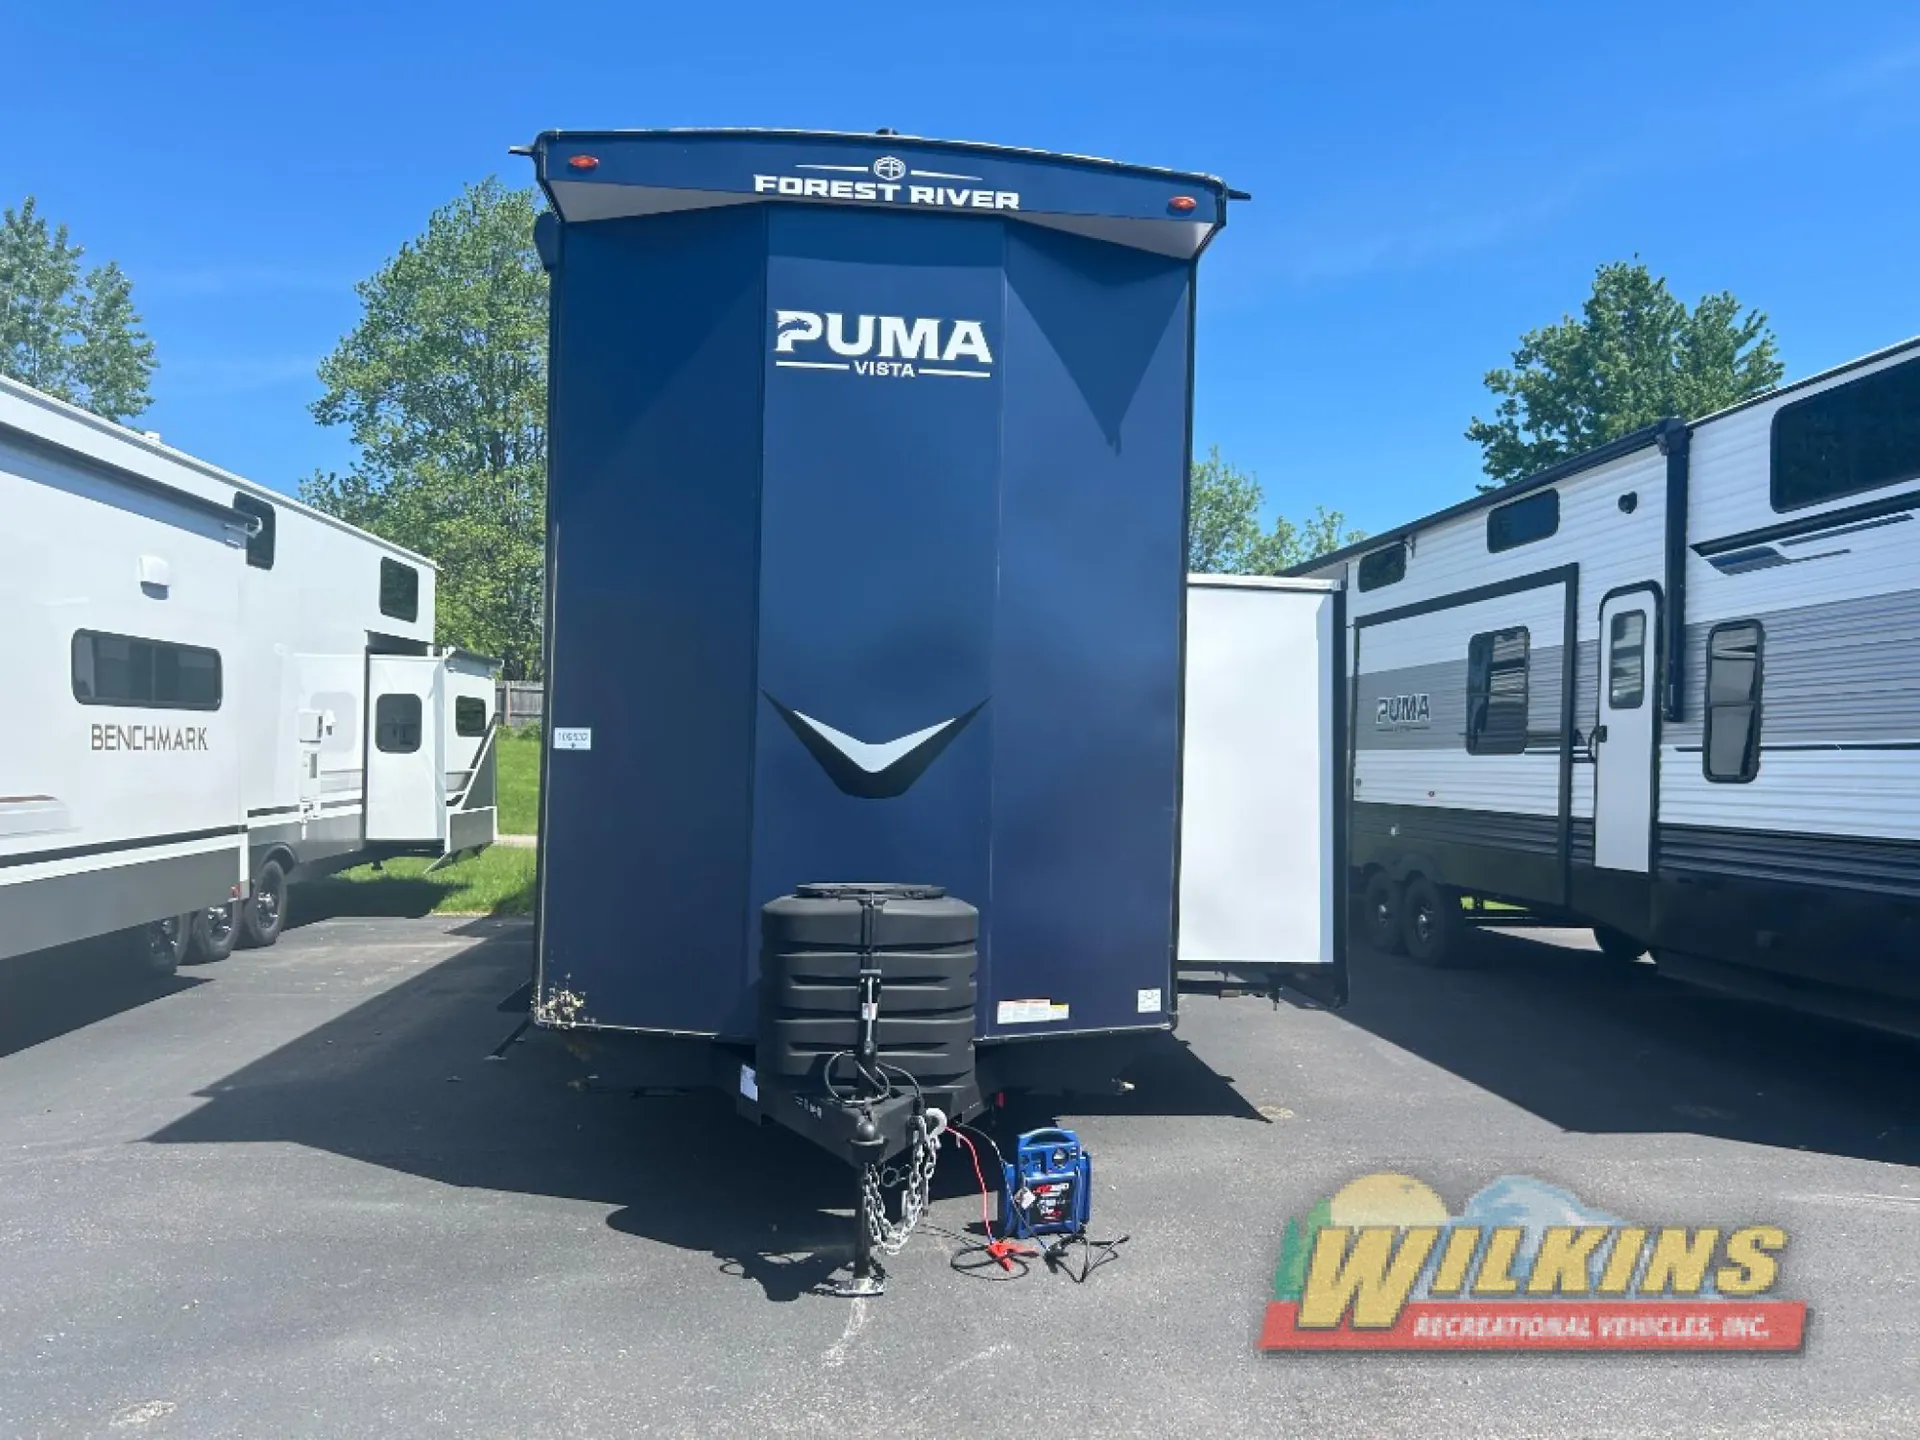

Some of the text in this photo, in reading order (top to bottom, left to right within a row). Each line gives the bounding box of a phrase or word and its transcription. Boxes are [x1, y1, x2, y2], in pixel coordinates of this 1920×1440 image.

[754, 174, 1020, 211] FOREST RIVER
[774, 309, 993, 364] PUMA
[853, 360, 916, 378] VISTA
[1376, 694, 1431, 724] PUMA
[91, 723, 209, 751] BENCHMARK
